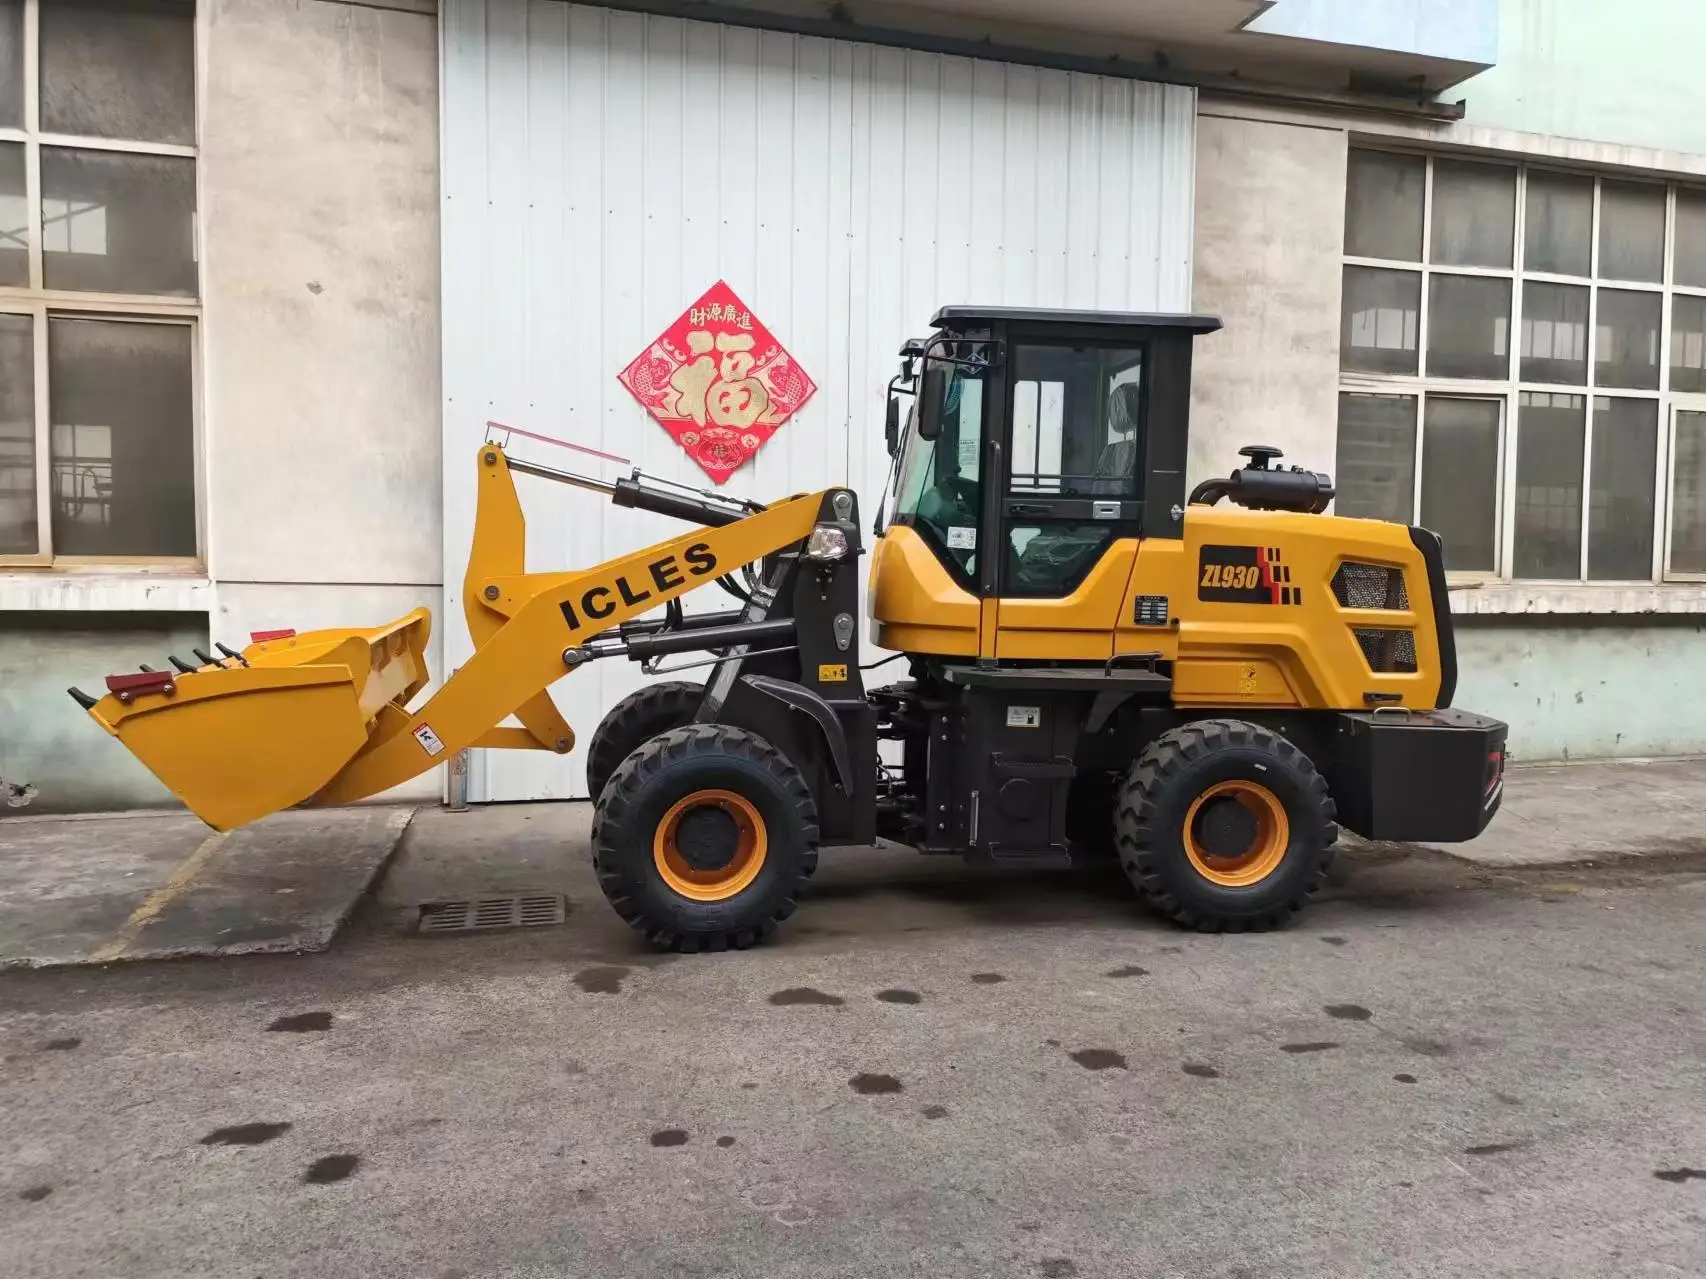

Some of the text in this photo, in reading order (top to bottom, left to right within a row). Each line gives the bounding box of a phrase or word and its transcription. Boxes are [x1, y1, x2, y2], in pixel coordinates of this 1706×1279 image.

[689, 303, 754, 330] 財源廣進
[669, 330, 769, 429] 福
[559, 543, 717, 631] ICLES
[1201, 564, 1260, 589] ZL930
